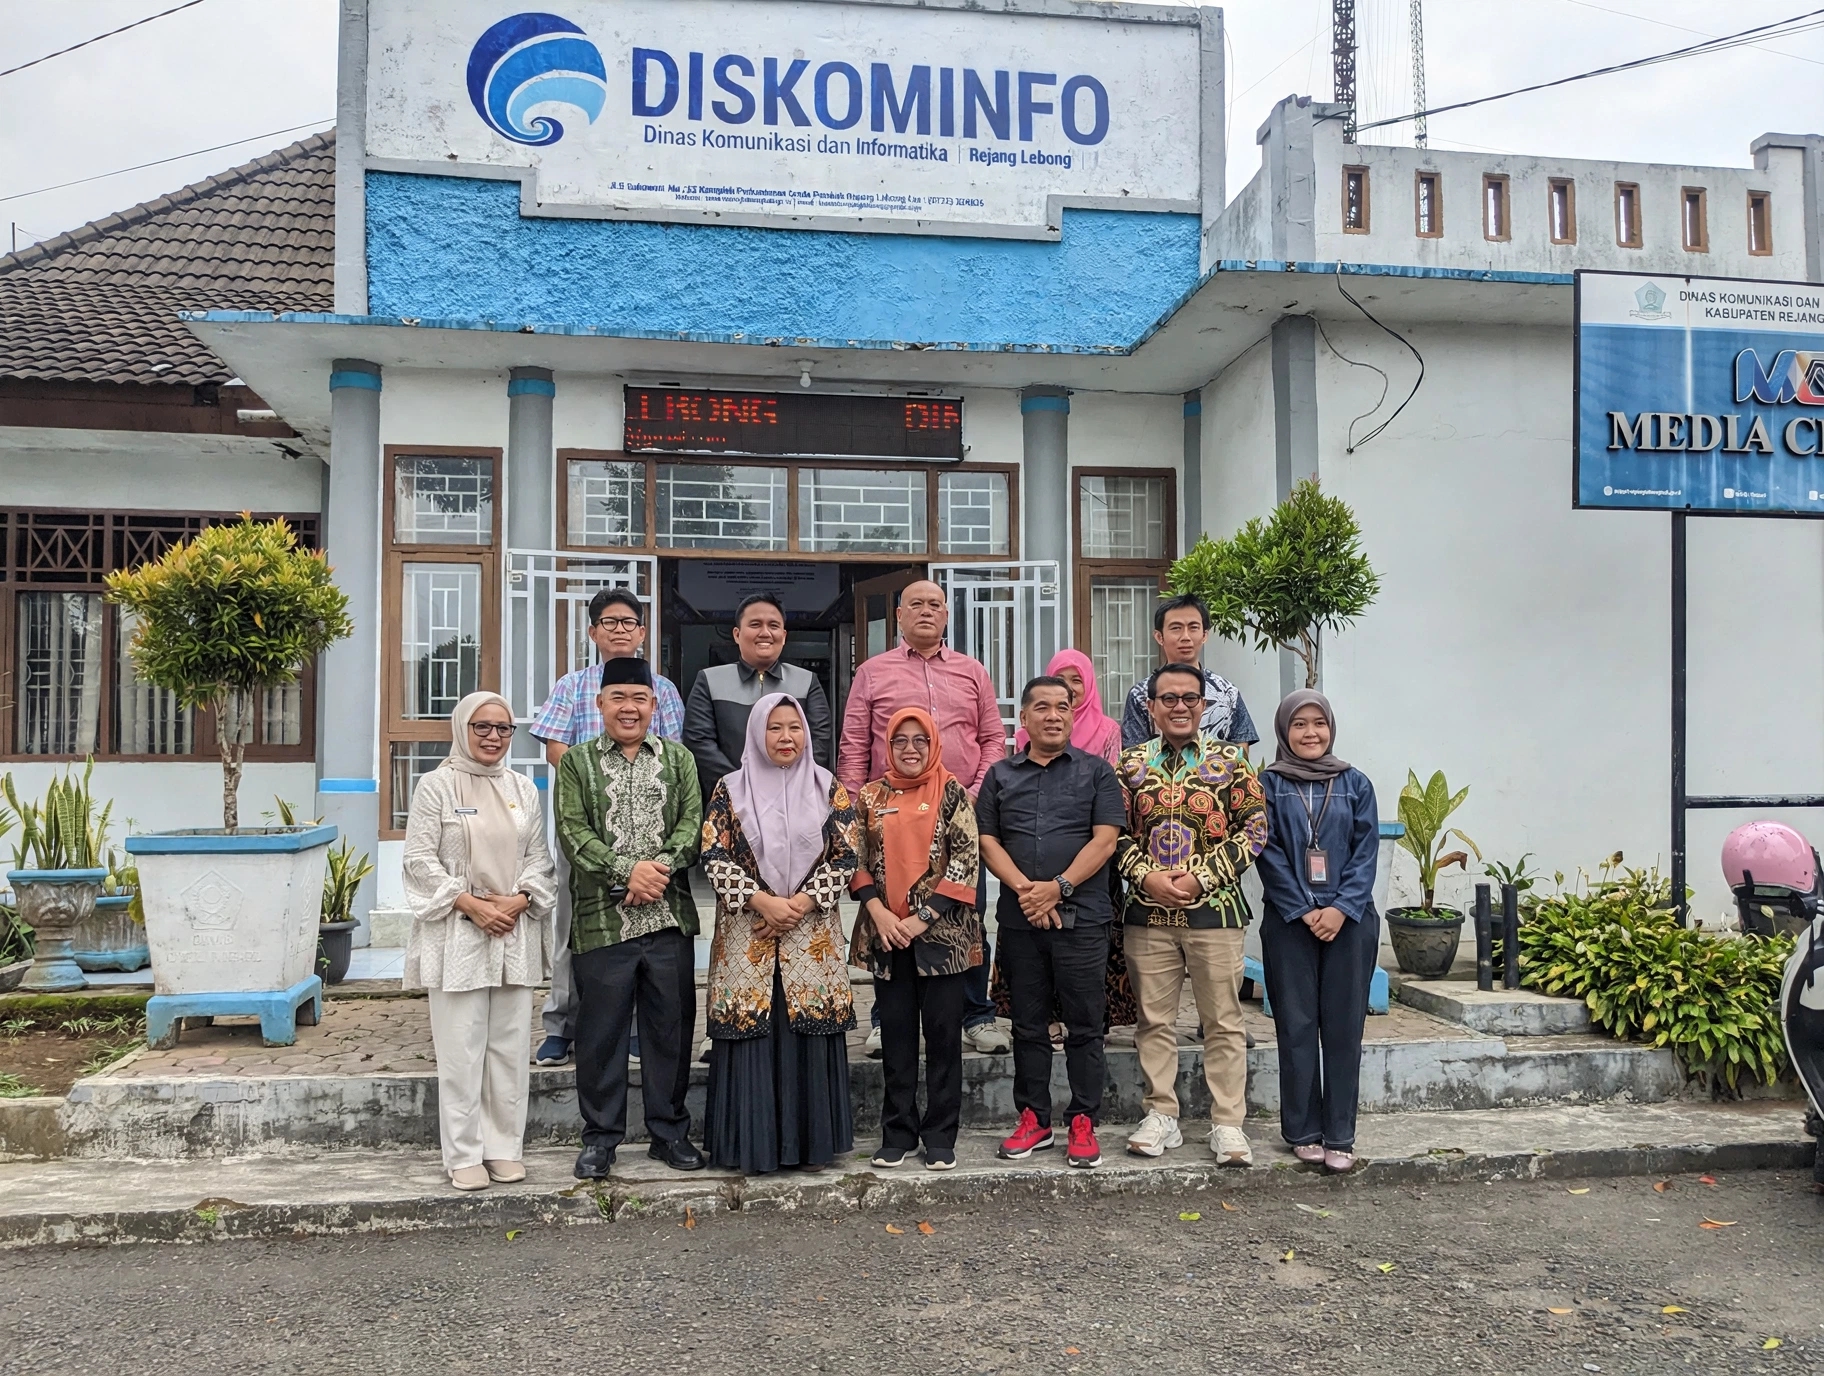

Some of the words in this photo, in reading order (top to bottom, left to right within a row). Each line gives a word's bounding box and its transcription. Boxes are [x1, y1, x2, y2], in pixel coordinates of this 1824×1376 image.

[632, 47, 1109, 145] DISKOMINFO
[644, 125, 696, 146] Dinas
[702, 129, 811, 153] Komunikasi
[818, 135, 851, 155] dan
[856, 138, 948, 162] Informatika
[969, 147, 1017, 167] Rejang
[1021, 149, 1072, 169] Lebong
[1680, 290, 1716, 303] DINAS
[1719, 293, 1793, 308] KOMUNIKASI
[1705, 307, 1775, 322] KABUPATEN
[1607, 411, 1774, 453] MEDIA
